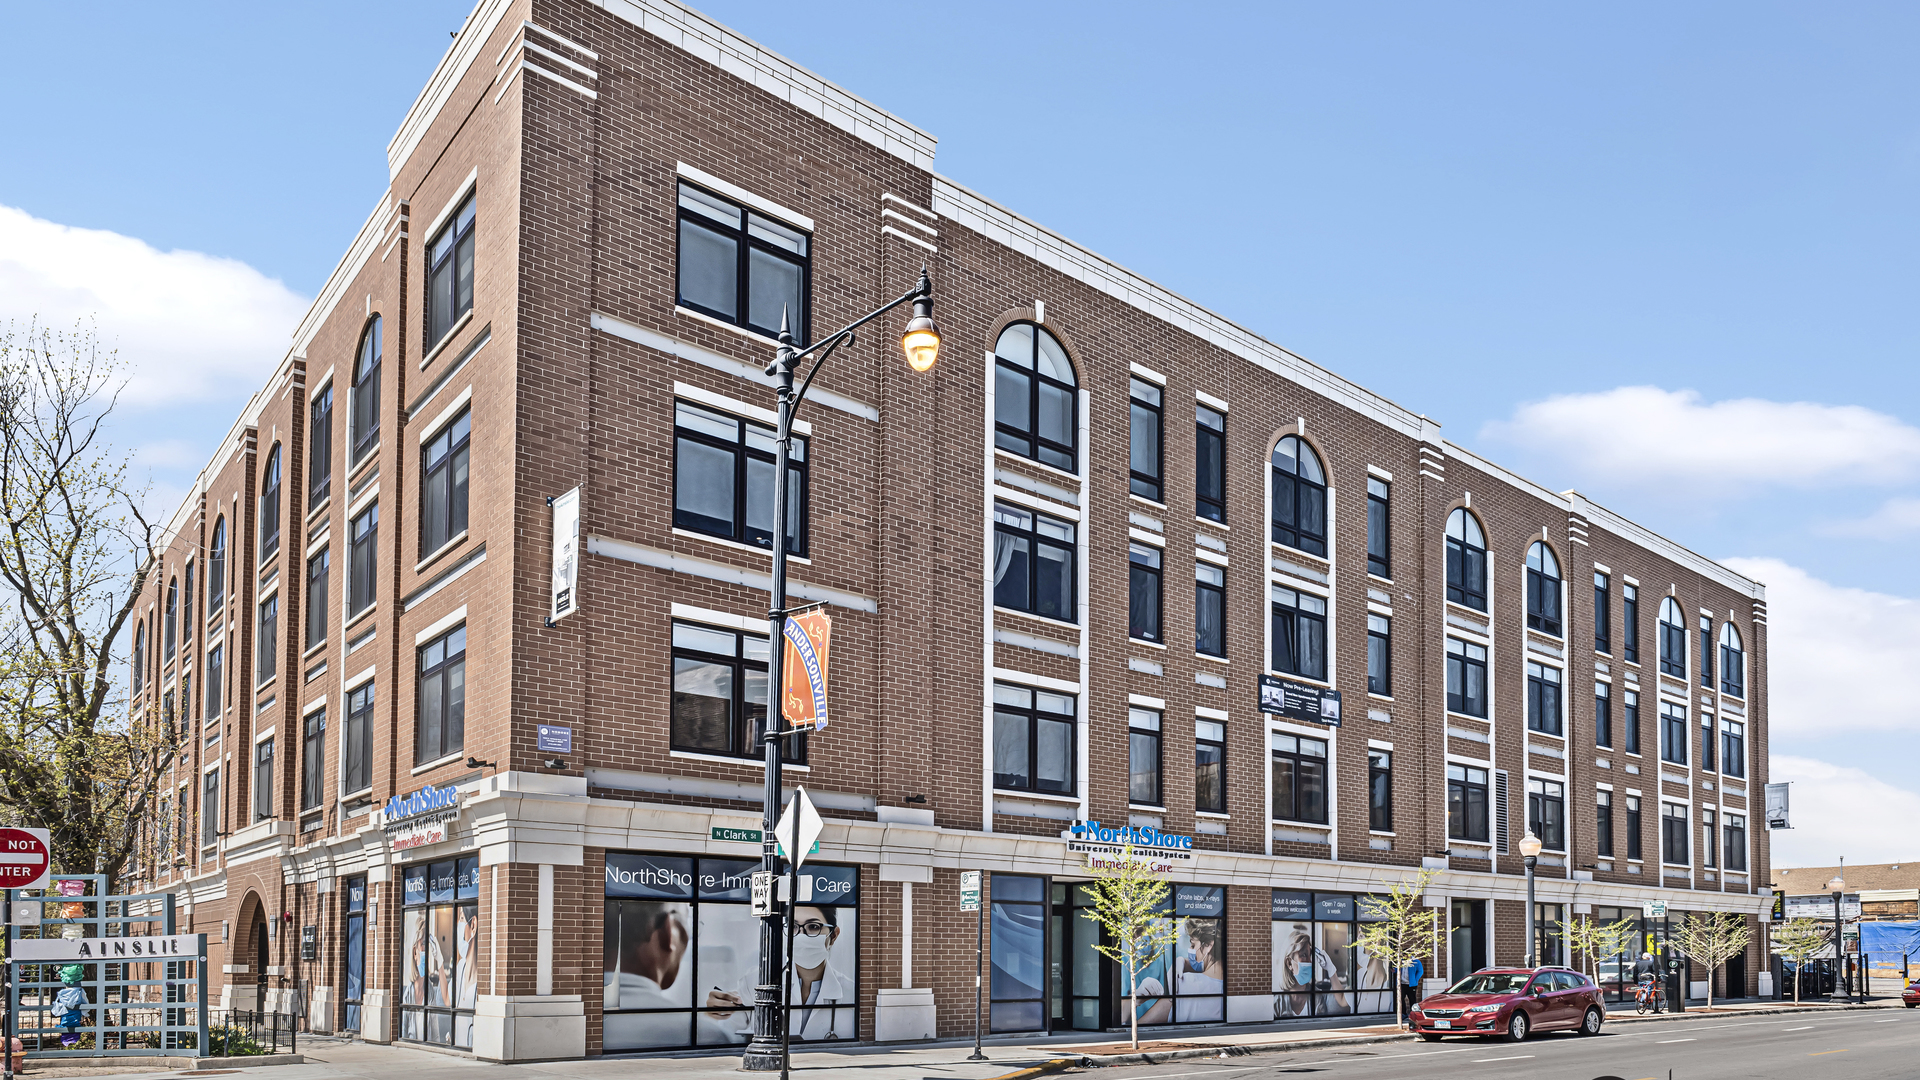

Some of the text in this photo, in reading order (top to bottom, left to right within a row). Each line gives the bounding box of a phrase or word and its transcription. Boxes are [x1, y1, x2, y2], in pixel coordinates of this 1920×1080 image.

[786, 622, 826, 724] ANDERSONVILLE
[391, 785, 457, 819] NorthShore
[426, 831, 442, 844] Care
[724, 830, 748, 840] Clark
[1086, 820, 1192, 849] NorthShore
[8, 840, 37, 850] NOT
[1068, 843, 1122, 856] University
[0, 866, 31, 876] TER
[1092, 857, 1173, 873] Immedate Care
[605, 866, 715, 888] NorthShore
[754, 876, 769, 886] ONE
[815, 876, 851, 893] Care
[754, 888, 769, 898] WAY
[79, 939, 178, 957] AINSLIE
